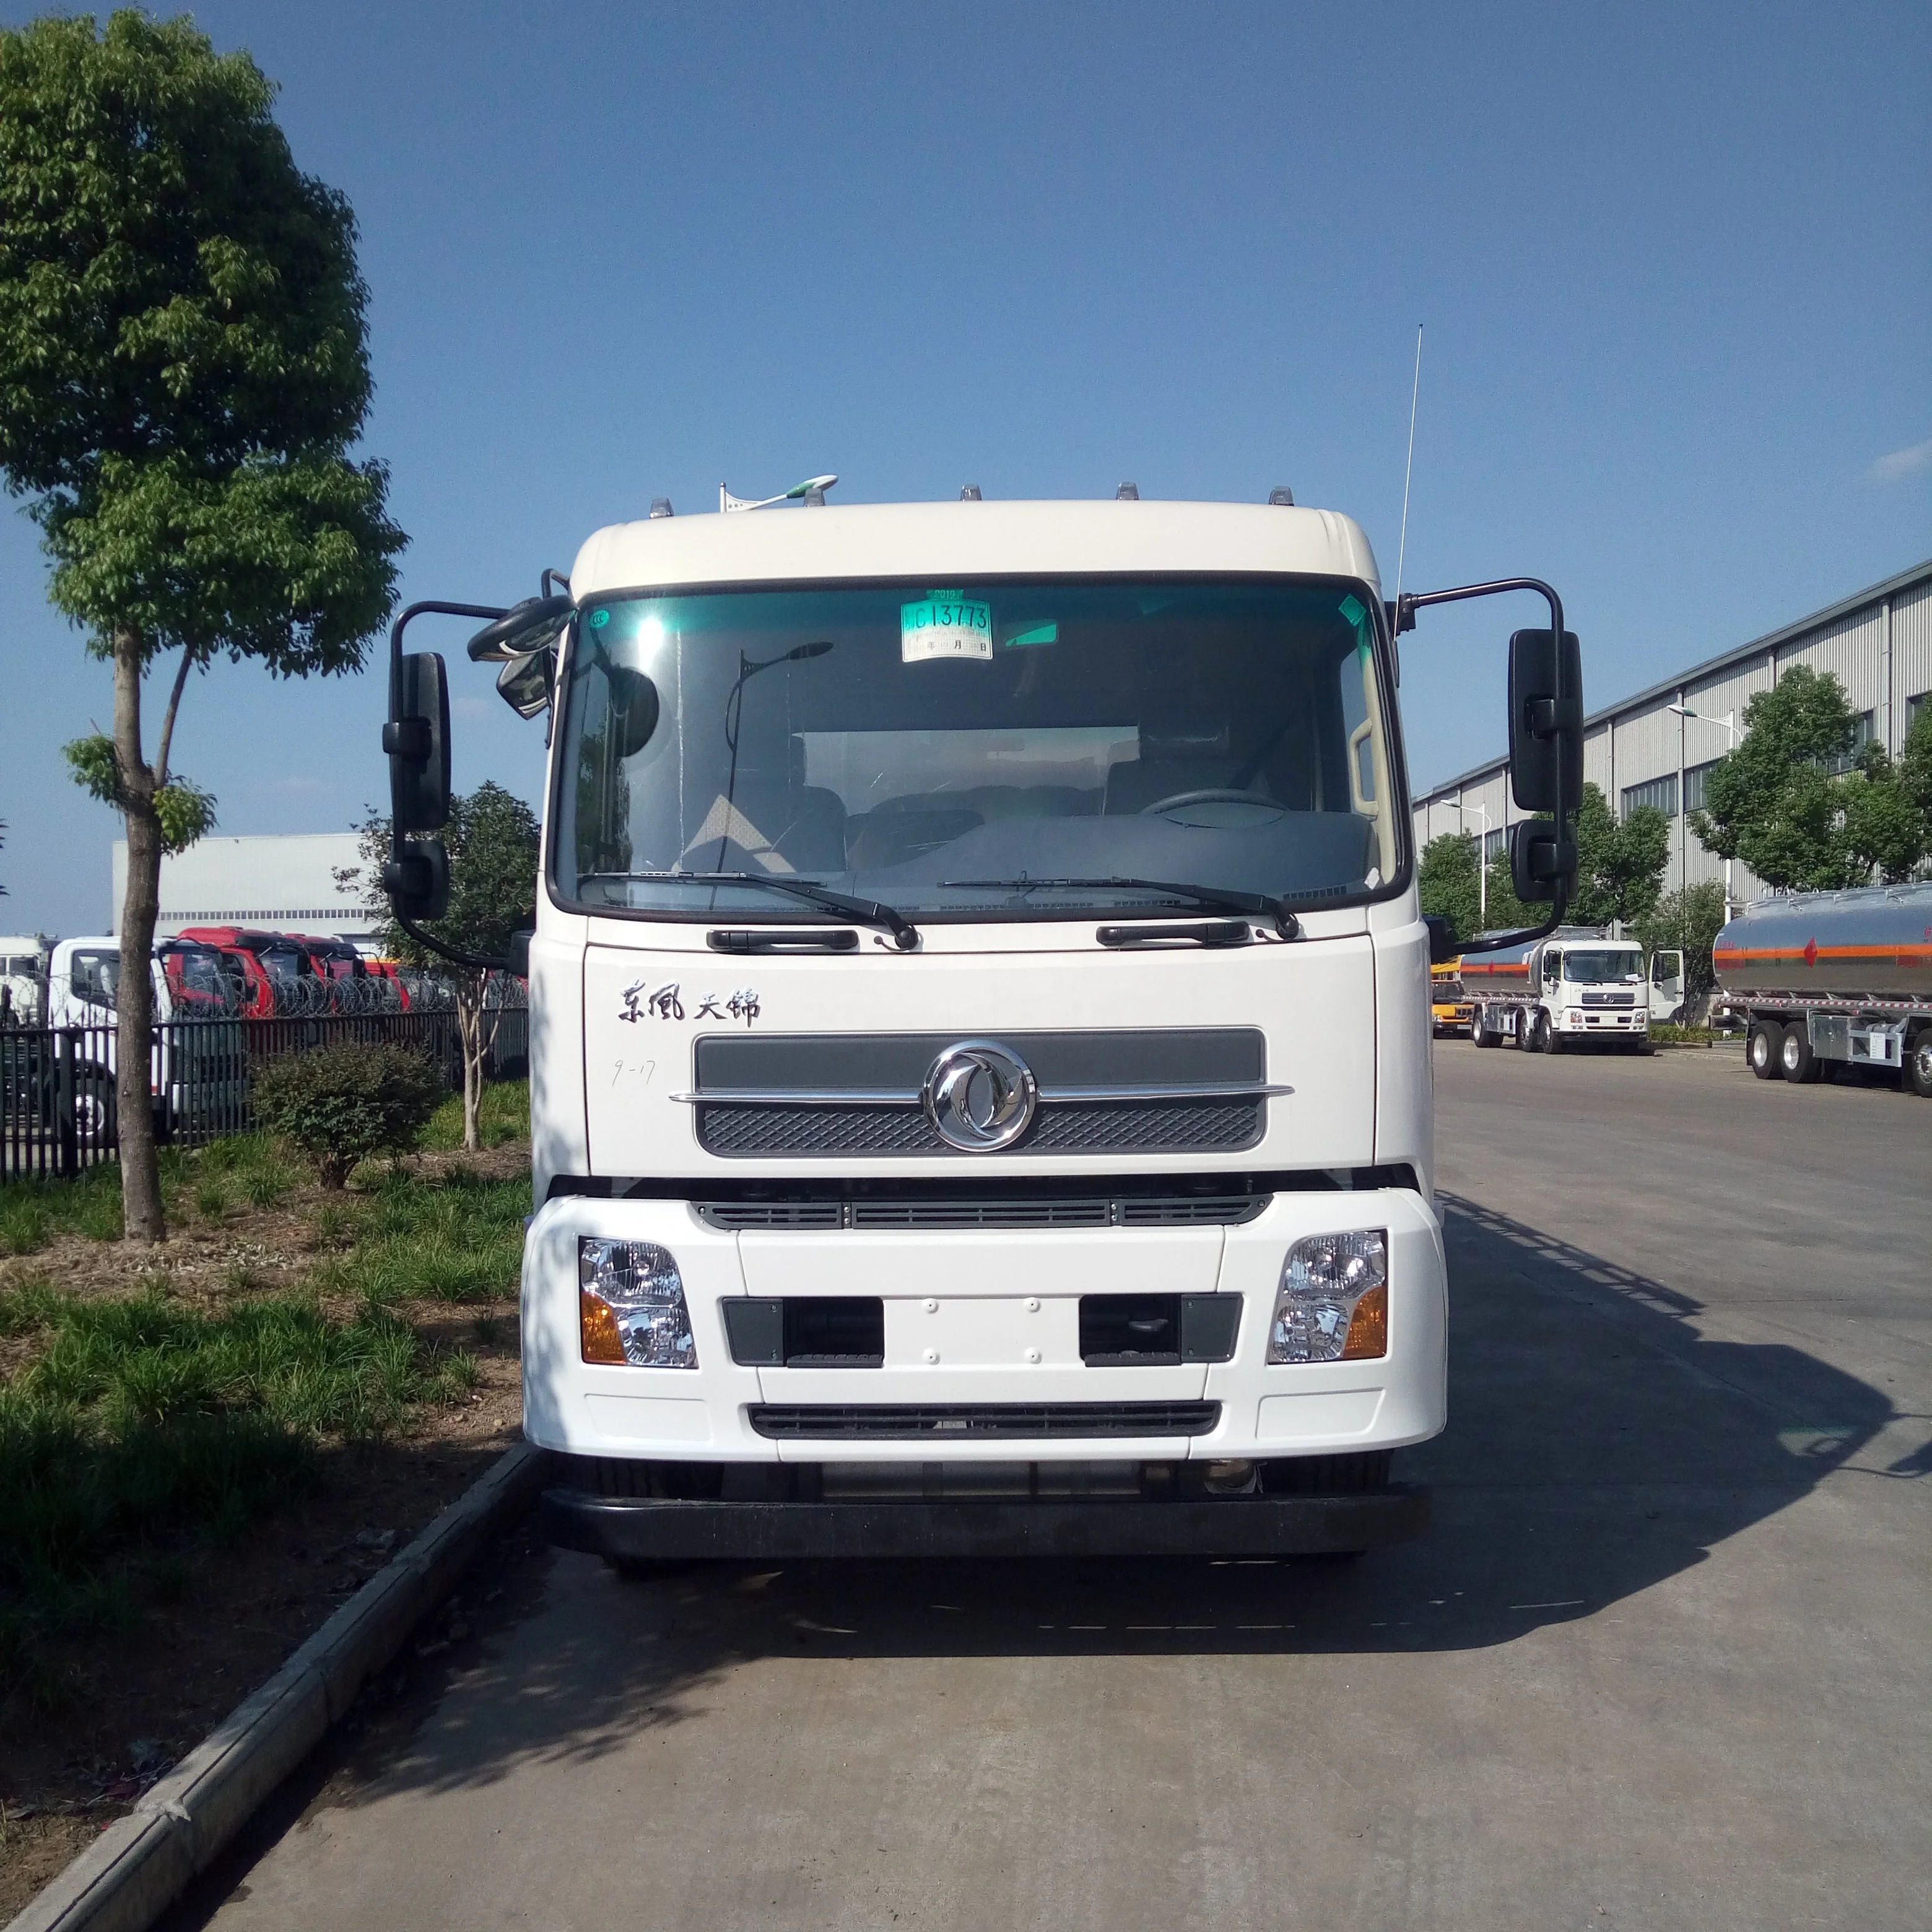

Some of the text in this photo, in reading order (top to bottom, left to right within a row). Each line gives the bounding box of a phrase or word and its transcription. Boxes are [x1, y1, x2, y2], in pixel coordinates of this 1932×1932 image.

[905, 605, 986, 629] C13773
[954, 640, 962, 650] 月
[980, 643, 986, 652] 日
